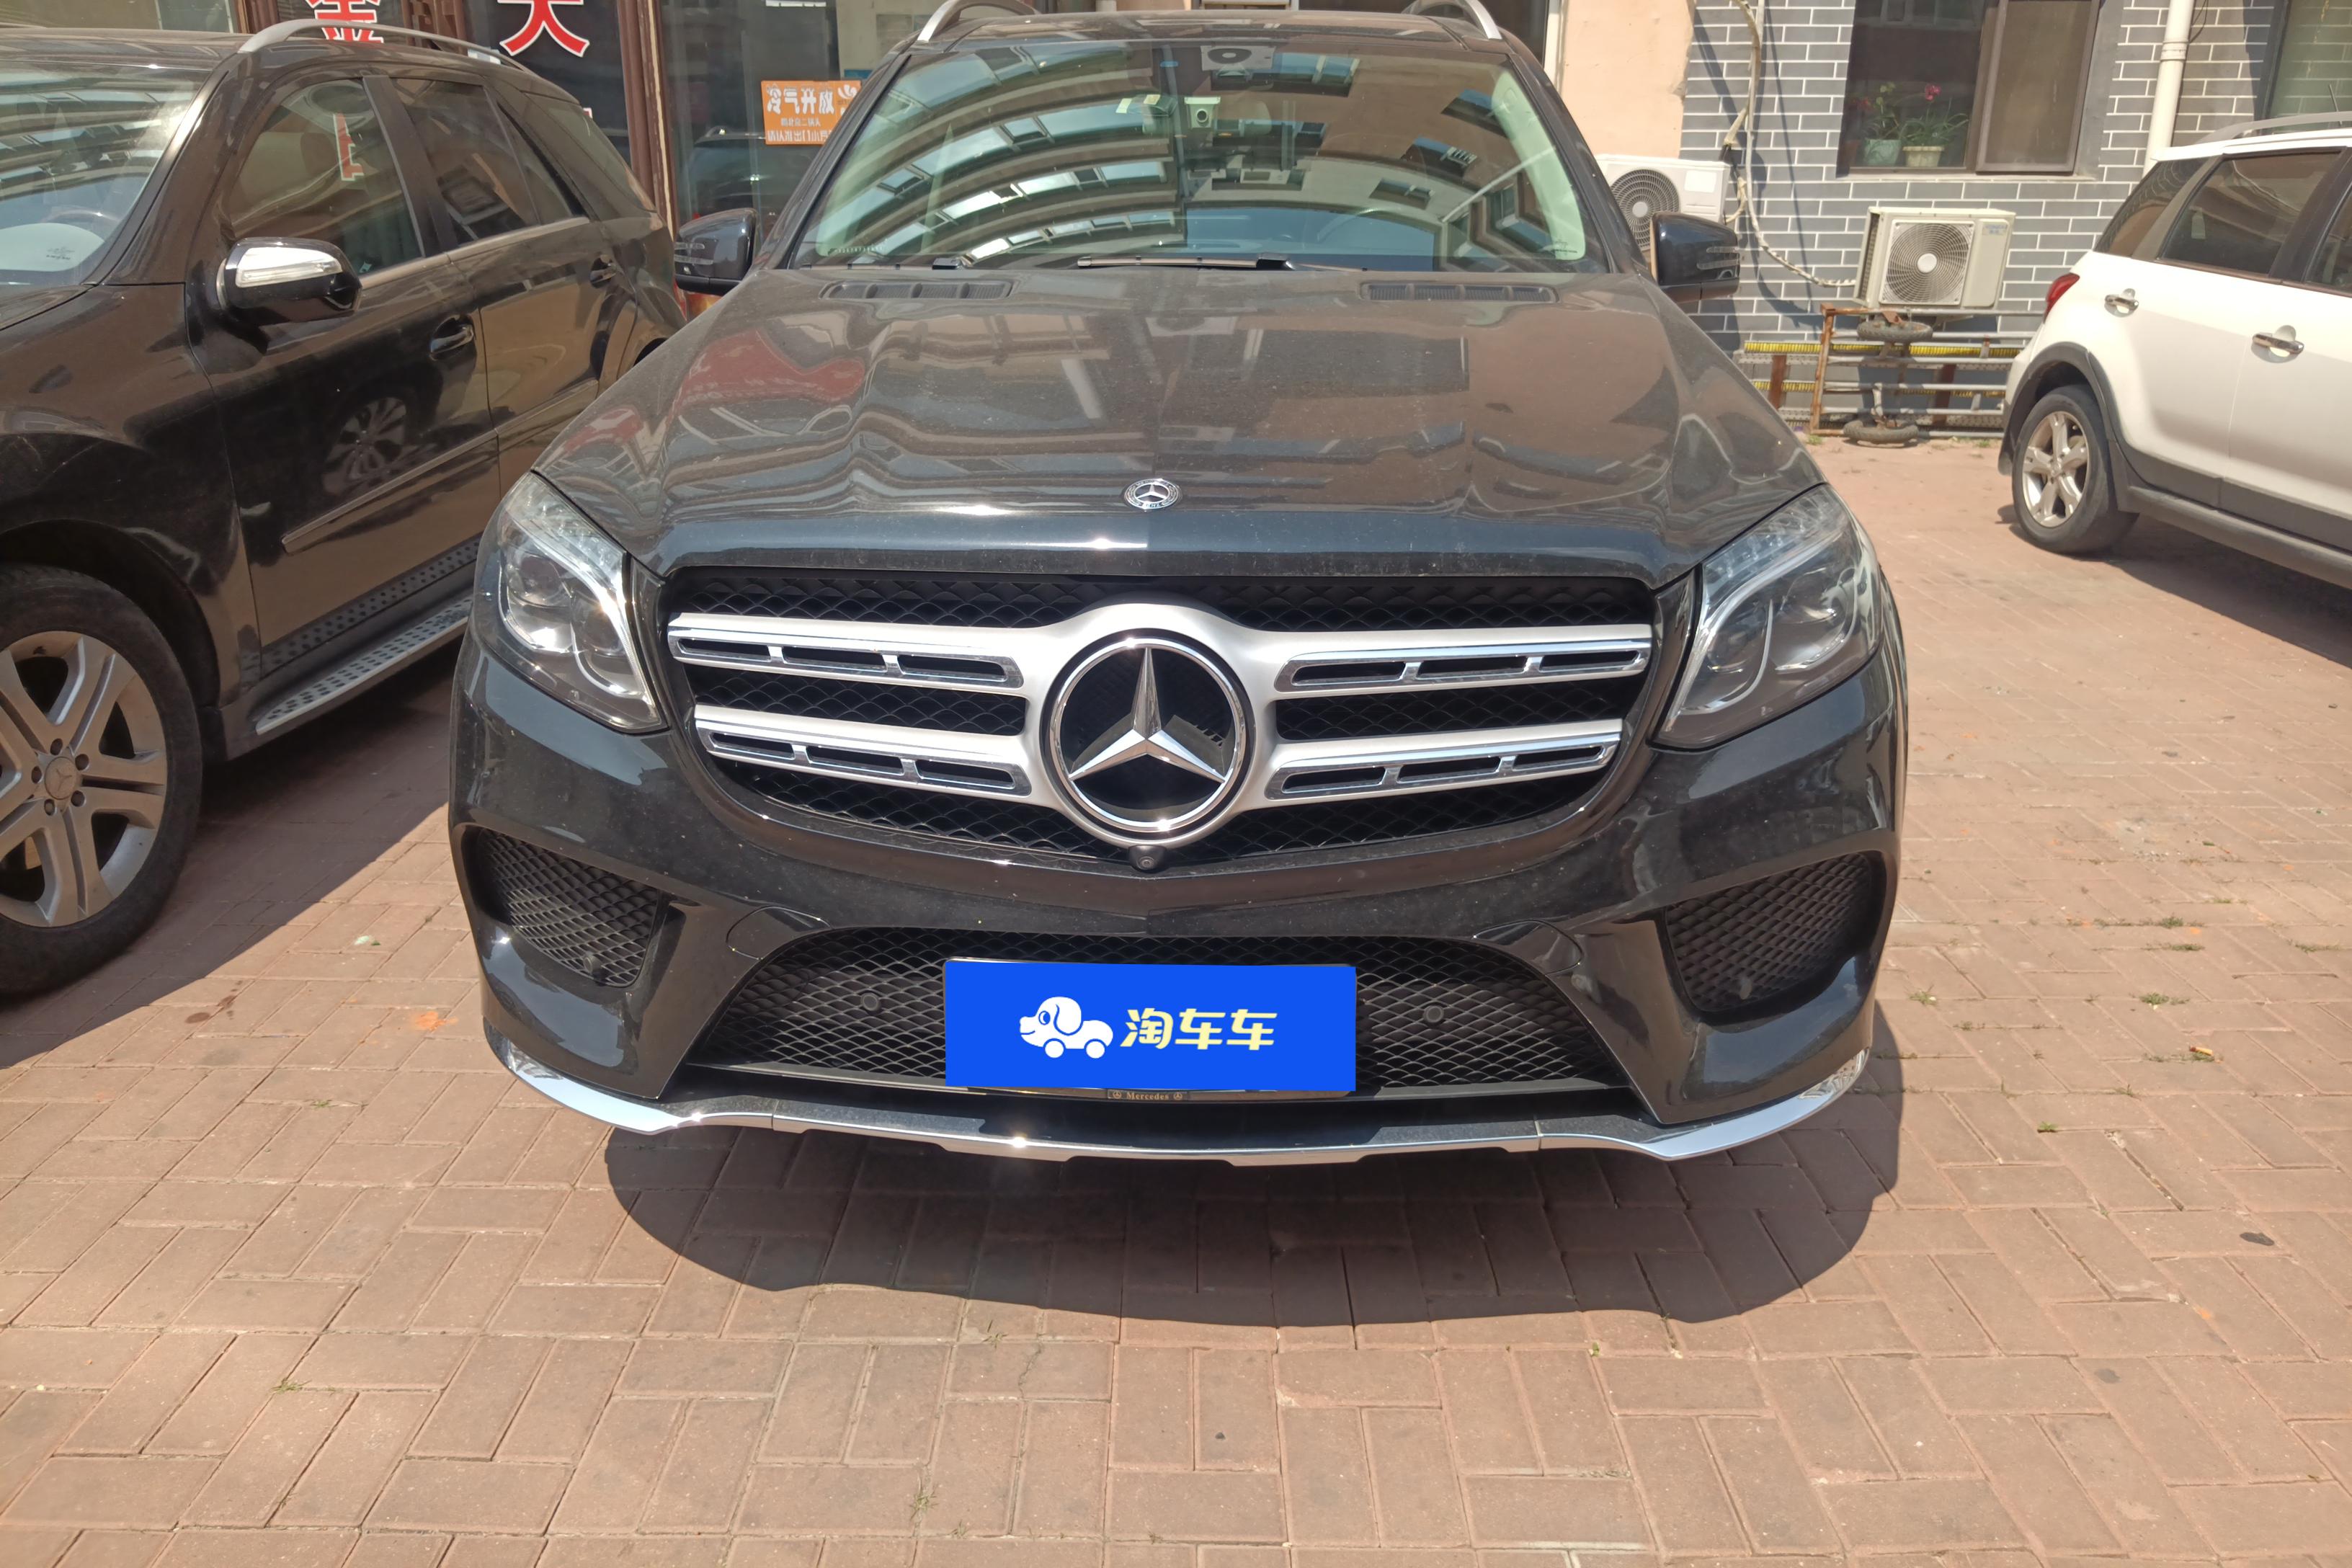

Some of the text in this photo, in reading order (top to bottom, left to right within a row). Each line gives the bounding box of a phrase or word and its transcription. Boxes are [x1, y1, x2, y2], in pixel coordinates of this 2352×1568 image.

[766, 84, 835, 115] 冷气开放
[1126, 1092, 1170, 1100] Mercedes
